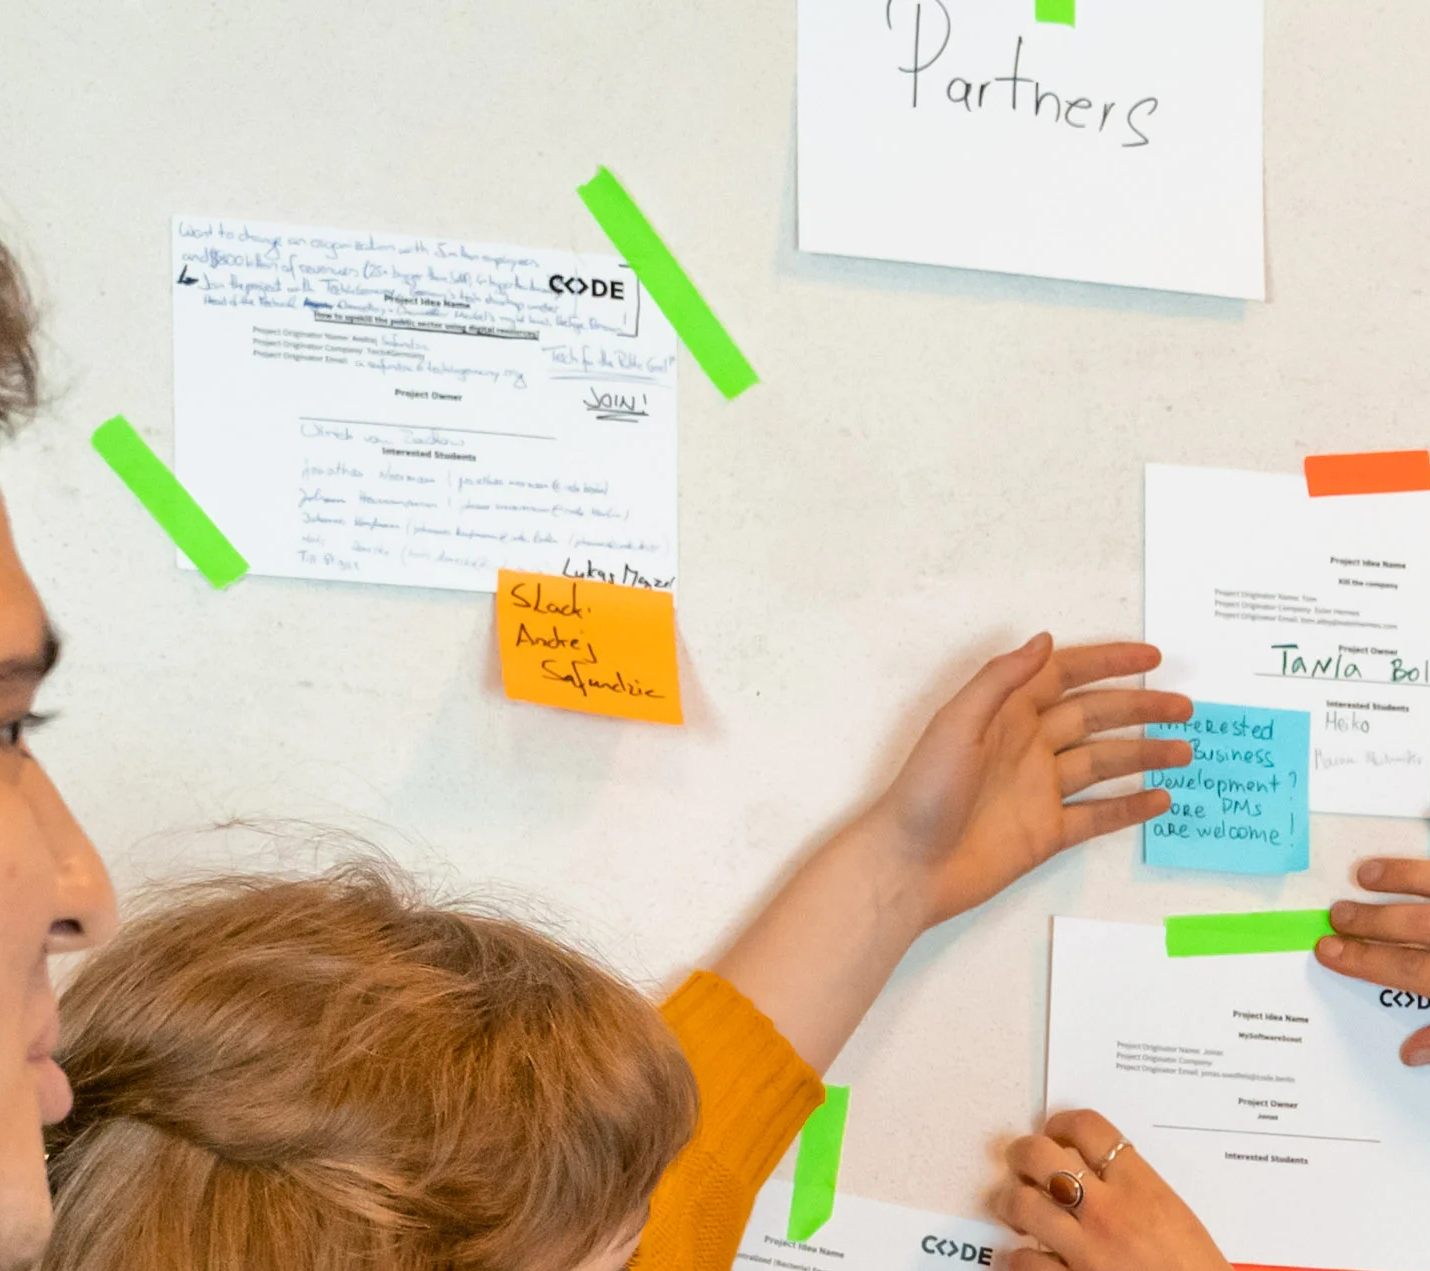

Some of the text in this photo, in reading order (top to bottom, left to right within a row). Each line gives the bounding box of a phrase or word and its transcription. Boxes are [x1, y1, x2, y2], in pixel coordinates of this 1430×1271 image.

[885, 0, 1159, 147] Partners
[384, 294, 418, 306] Project
[421, 297, 442, 307] Idea
[444, 300, 471, 309] Name
[394, 388, 463, 402] Project Owner
[381, 446, 477, 461] Interested Students
[1329, 556, 1407, 570] Project Idea Name
[1338, 644, 1398, 657] Project Owner
[1326, 699, 1410, 713] Interested Students
[1151, 769, 1281, 798] Development
[1232, 1009, 1309, 1024] Project Idea Name
[1238, 1097, 1298, 1110] Project Owner
[1225, 1151, 1309, 1165] Interested Students
[763, 1234, 845, 1259] Project Idea Name
